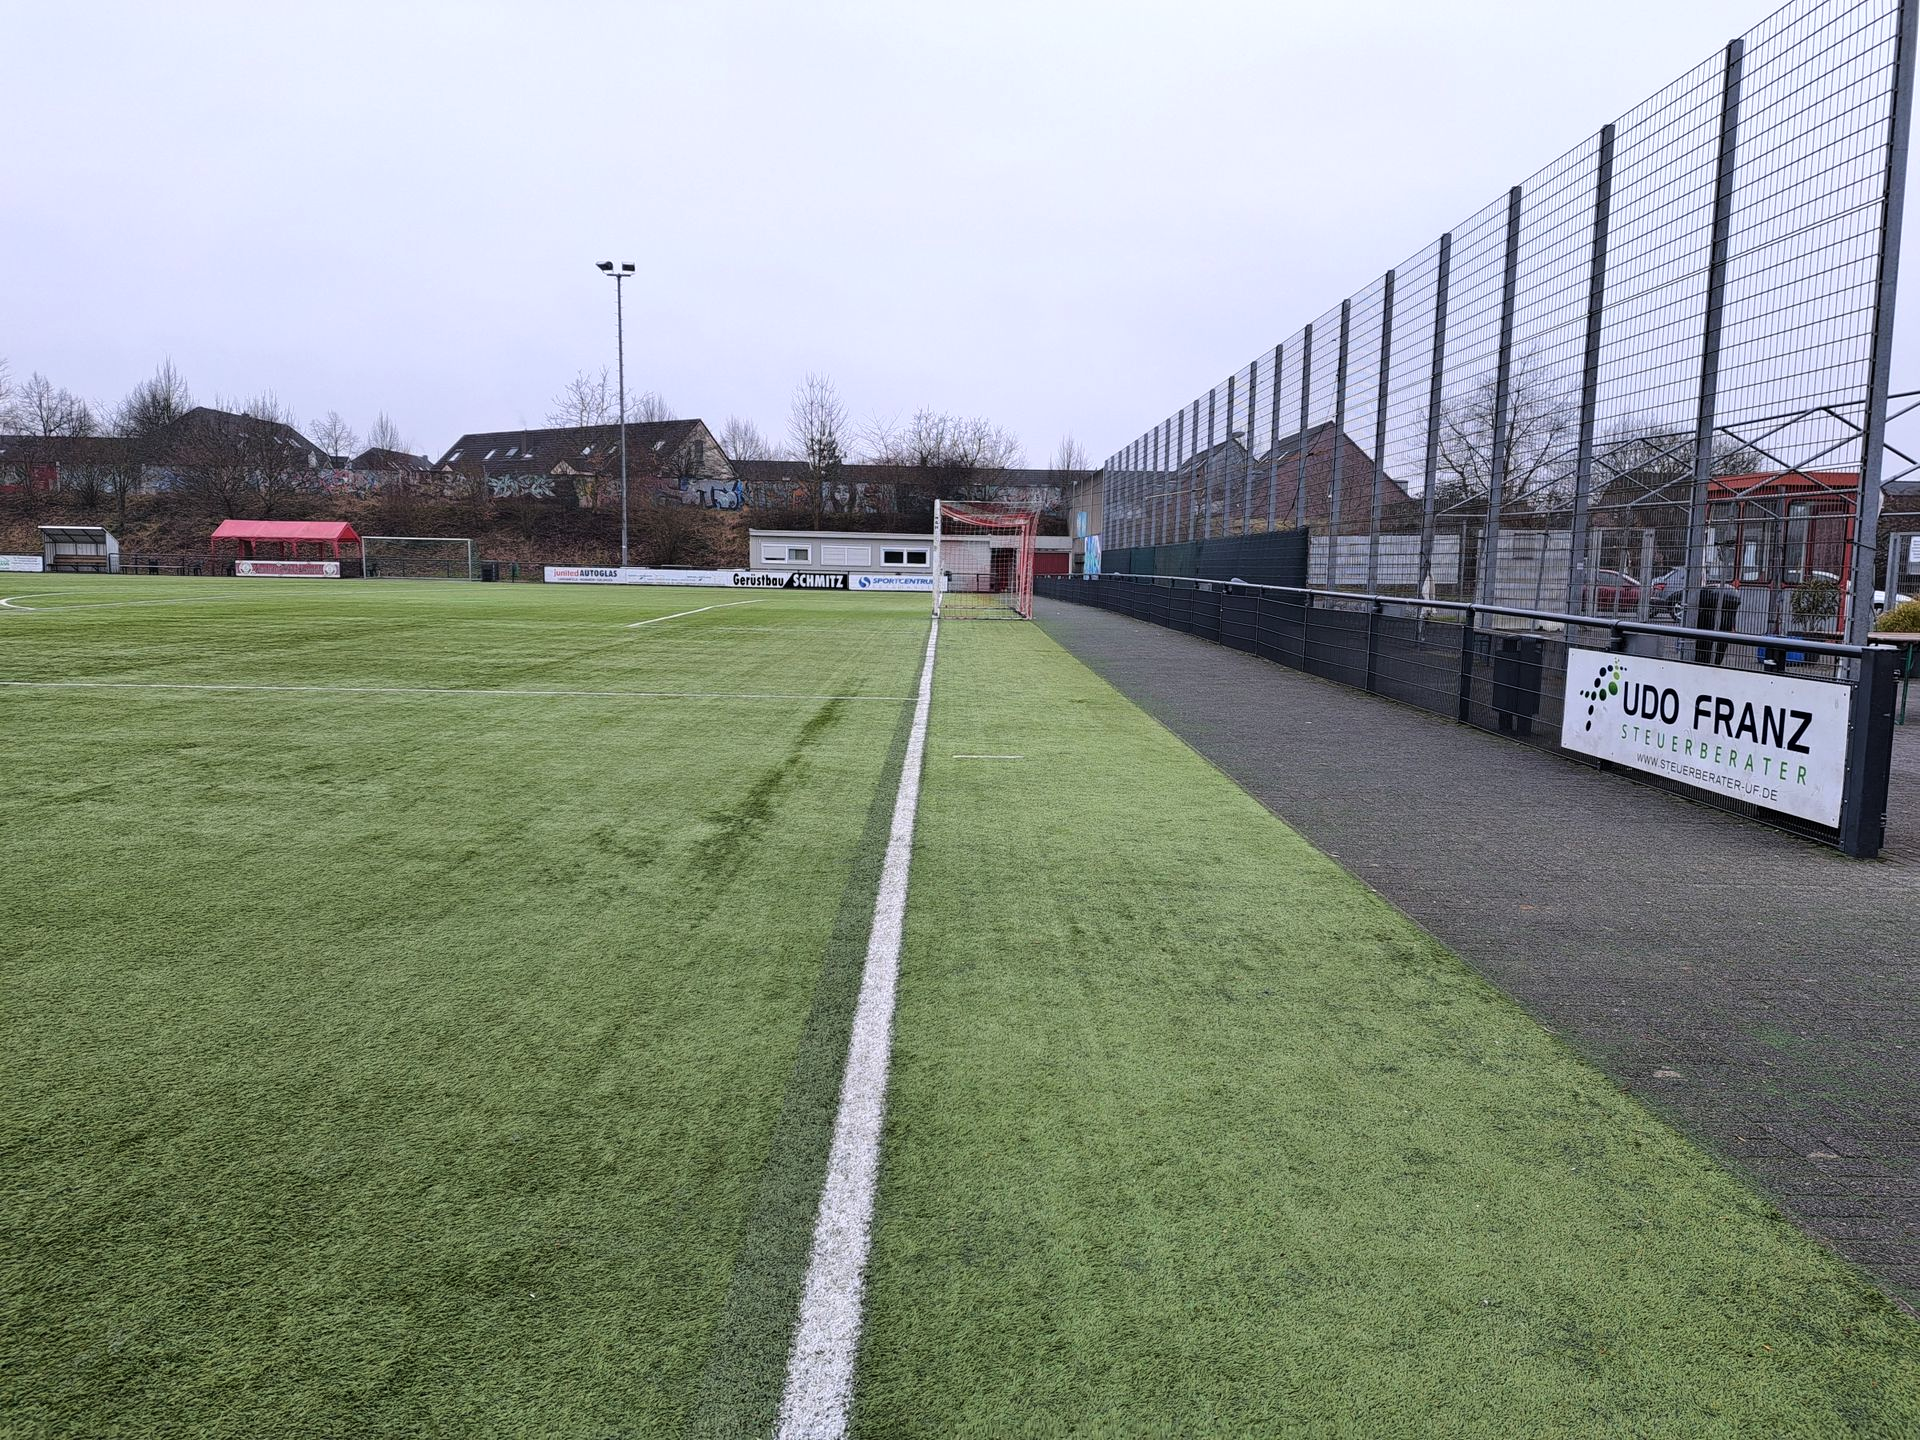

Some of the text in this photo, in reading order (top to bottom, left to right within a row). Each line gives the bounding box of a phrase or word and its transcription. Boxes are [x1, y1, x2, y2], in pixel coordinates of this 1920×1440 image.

[580, 569, 618, 577] AUTOGLAS
[733, 573, 844, 588] Gerüstbau SCHMITZ
[873, 577, 934, 585] SPORTCENTRU
[1623, 681, 1813, 755] UDO FRANZ
[1621, 724, 1808, 786] STEUERBERATER
[1636, 752, 1778, 802] WWW.STEUERBERATER-UF.DE
